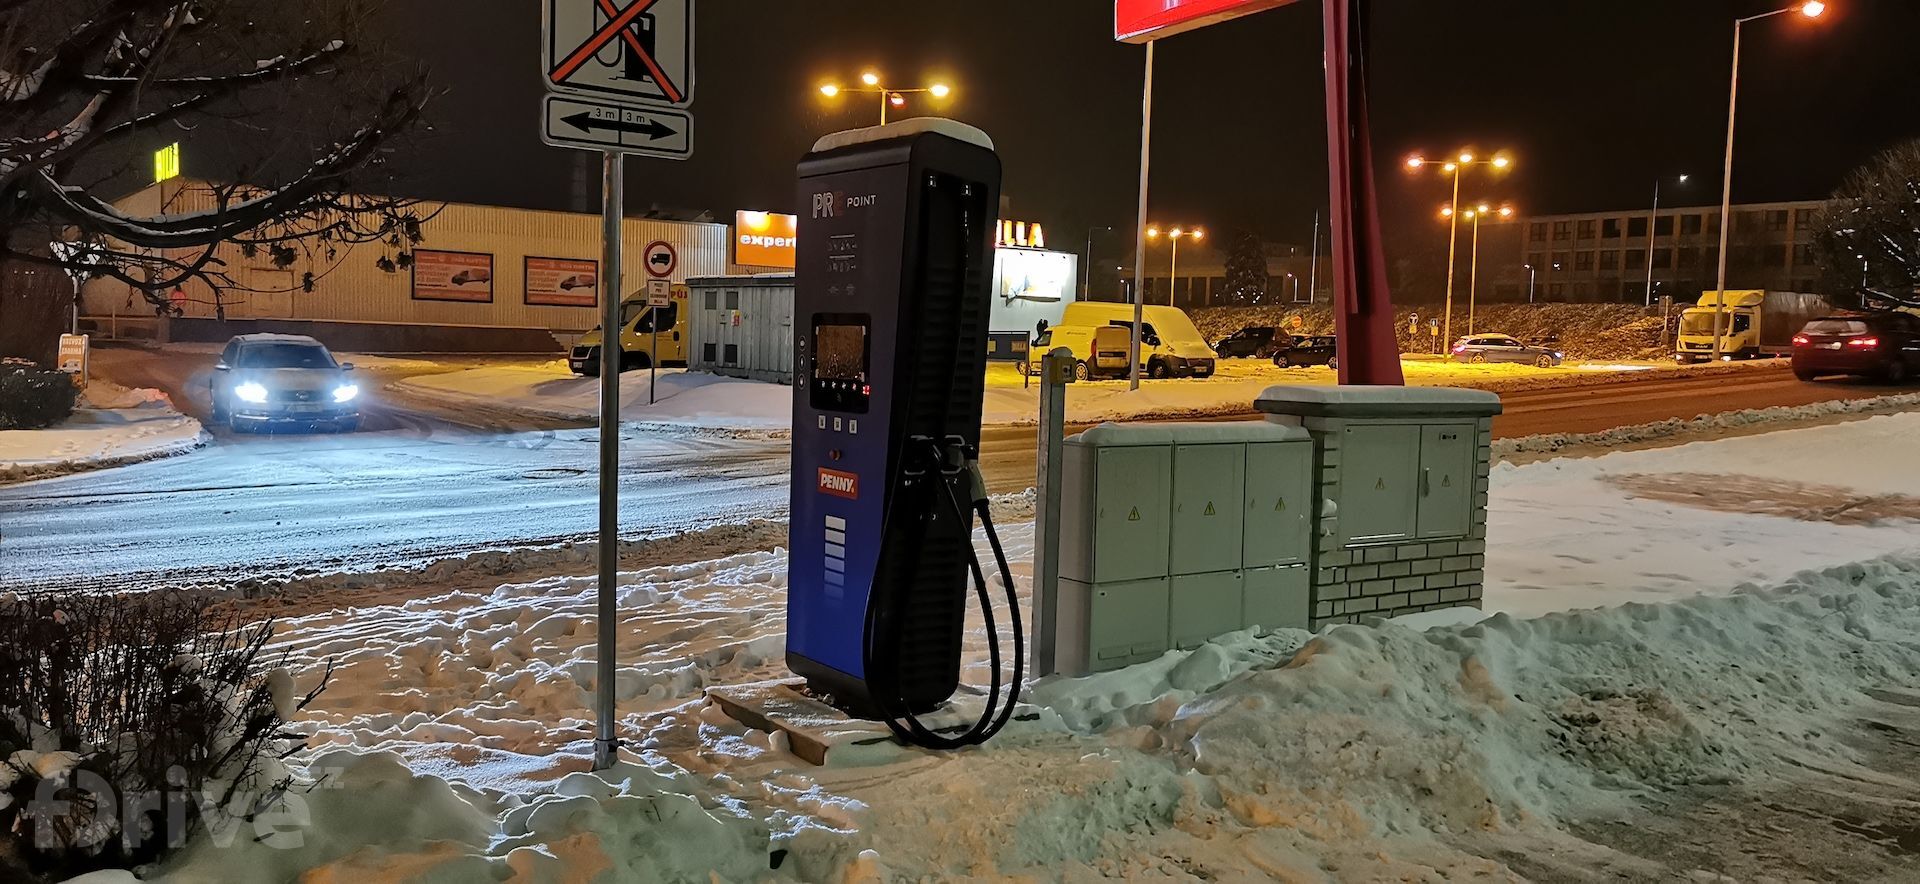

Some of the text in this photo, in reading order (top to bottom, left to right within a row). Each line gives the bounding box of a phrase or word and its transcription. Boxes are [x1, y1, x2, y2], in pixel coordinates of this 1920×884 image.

[595, 107, 615, 119] 3 m
[626, 111, 645, 123] 3 m
[846, 194, 877, 208] POINT
[995, 218, 1045, 248] ILLA
